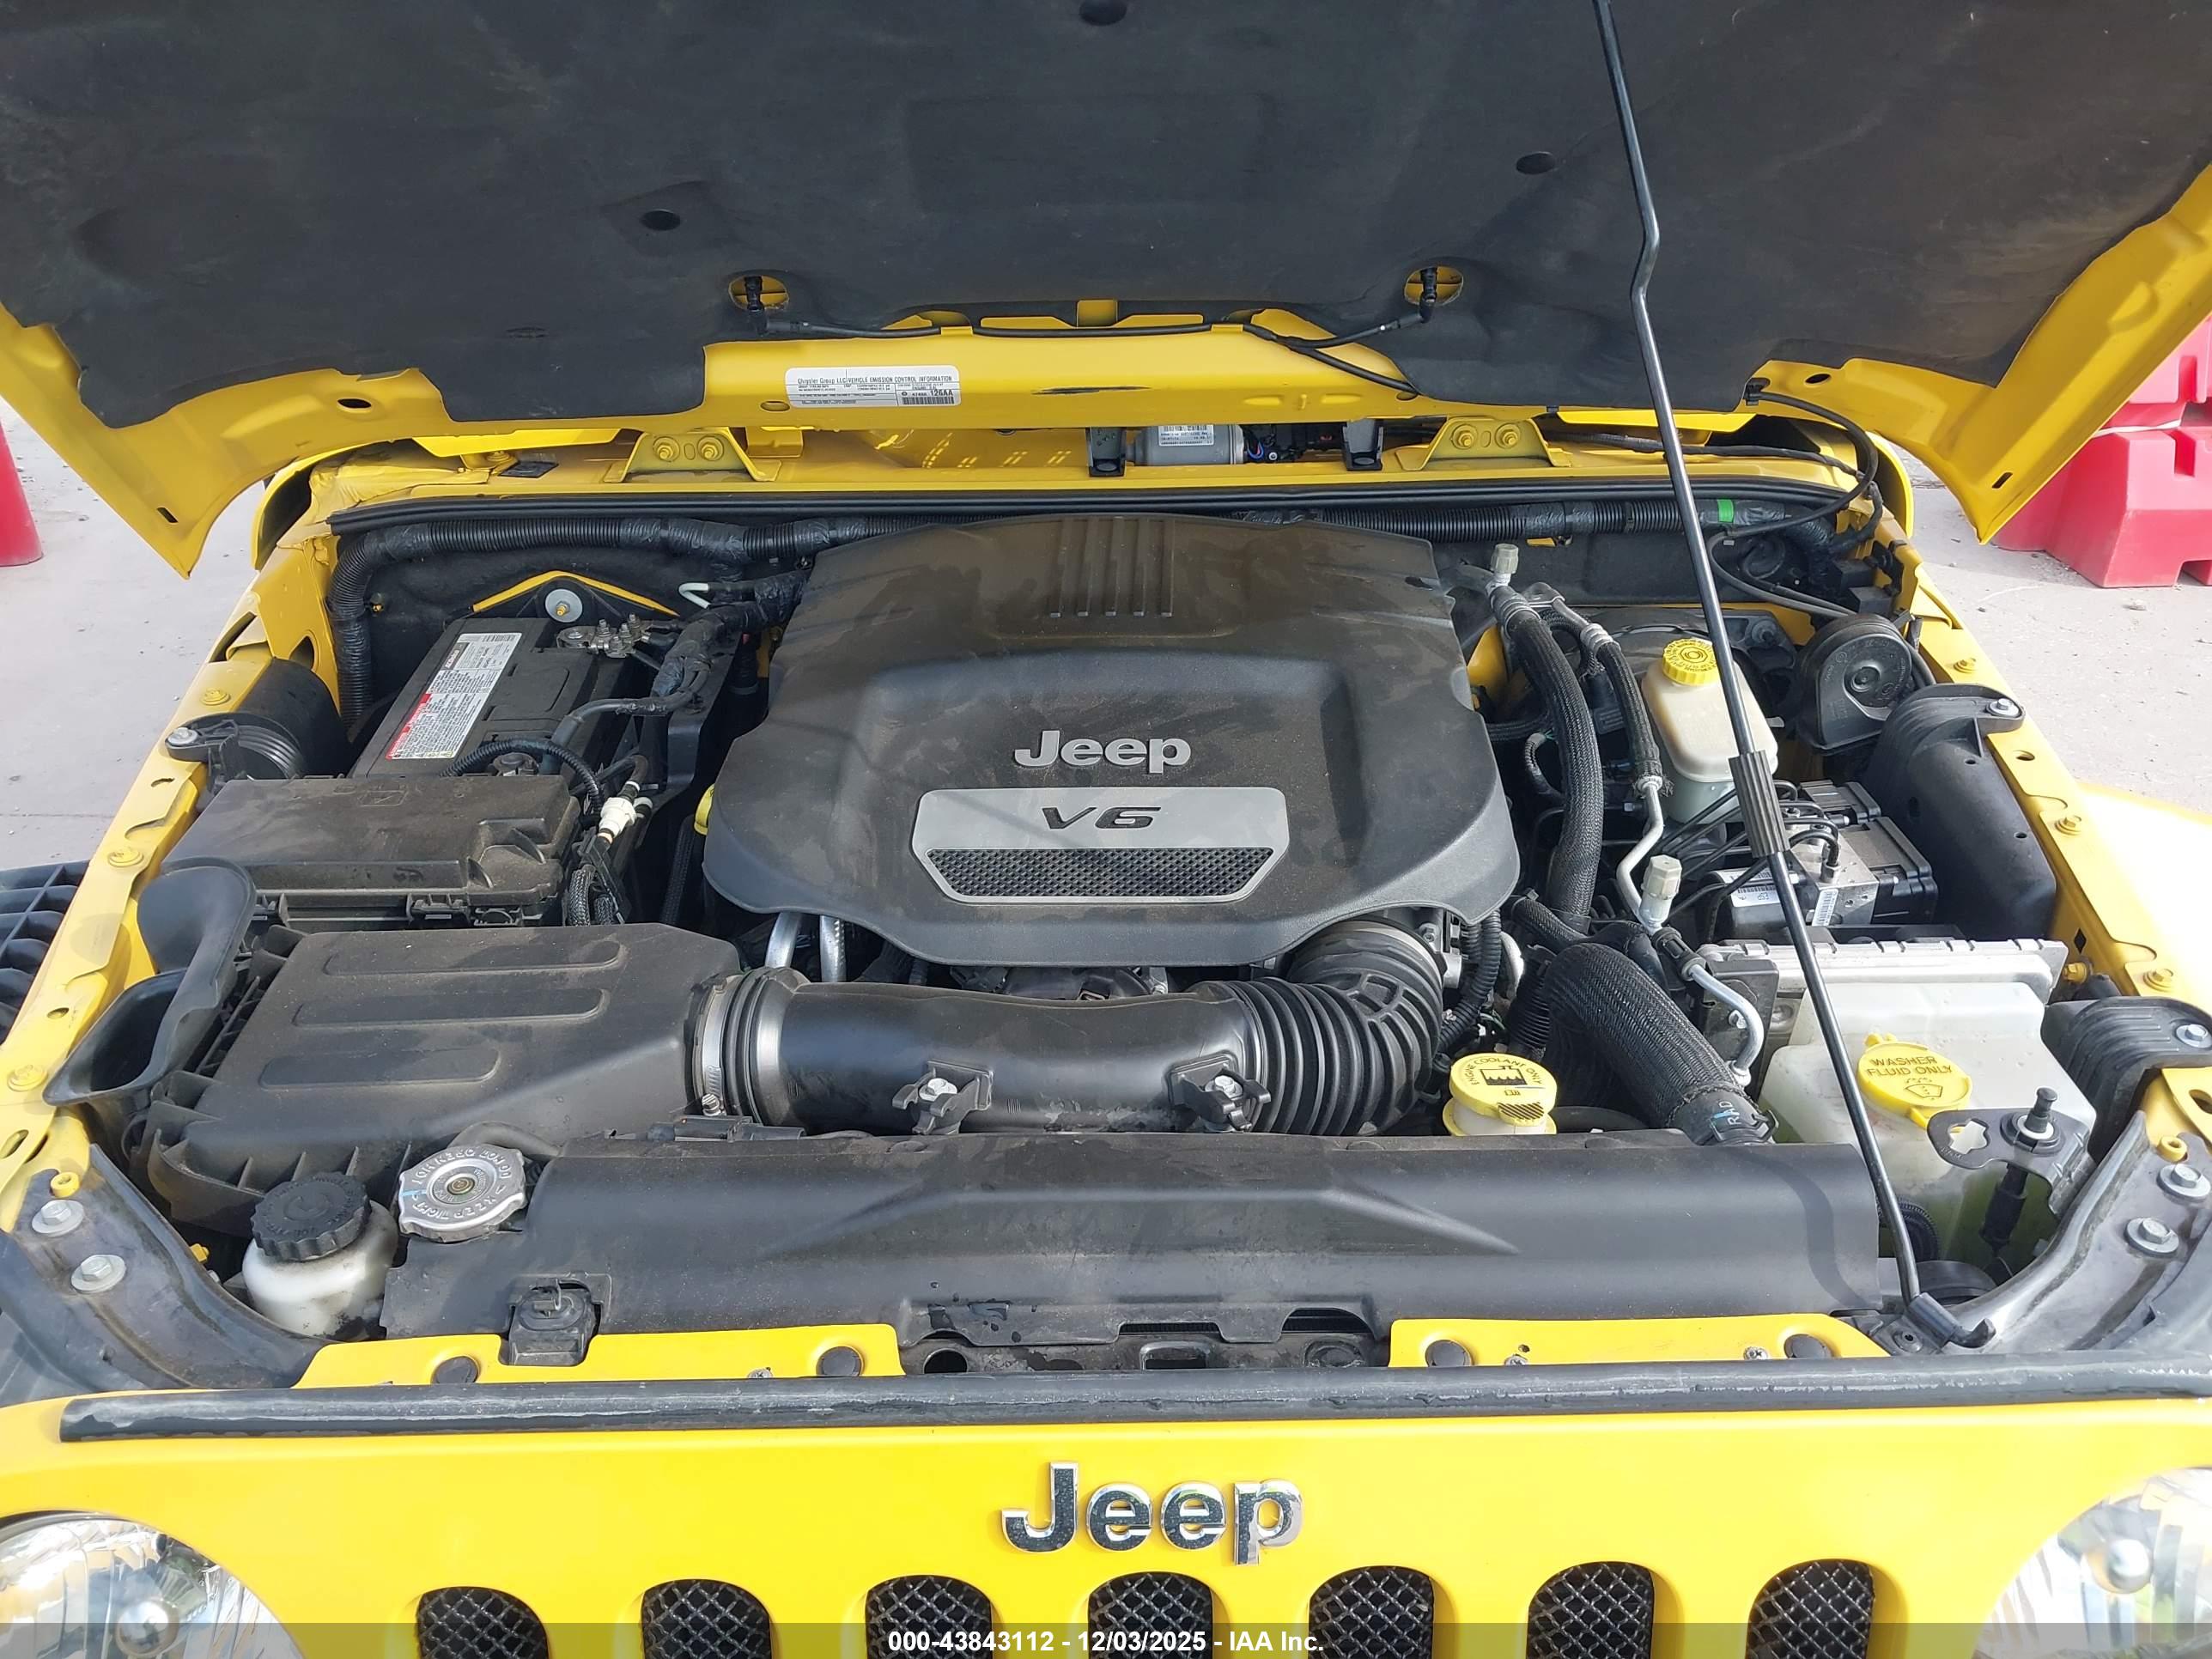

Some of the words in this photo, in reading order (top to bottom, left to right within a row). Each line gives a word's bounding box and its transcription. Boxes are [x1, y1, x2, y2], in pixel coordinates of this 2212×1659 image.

[1014, 730, 1192, 775] Jeep
[1042, 806, 1161, 830] V6
[1464, 1063, 1480, 1085] ENGINE
[1474, 1058, 1527, 1068] COOLANT
[1526, 1068, 1542, 1084] ONLY
[1867, 1066, 1911, 1076] FLUID
[1915, 1065, 1953, 1075] ONLY
[1870, 1056, 1937, 1066] WASHER
[1718, 1101, 1741, 1125] RAD
[479, 1149, 505, 1164] NOT
[412, 1202, 450, 1220] TIGHT
[453, 1195, 497, 1218] KEEP
[1001, 1461, 1304, 1566] Jeep
